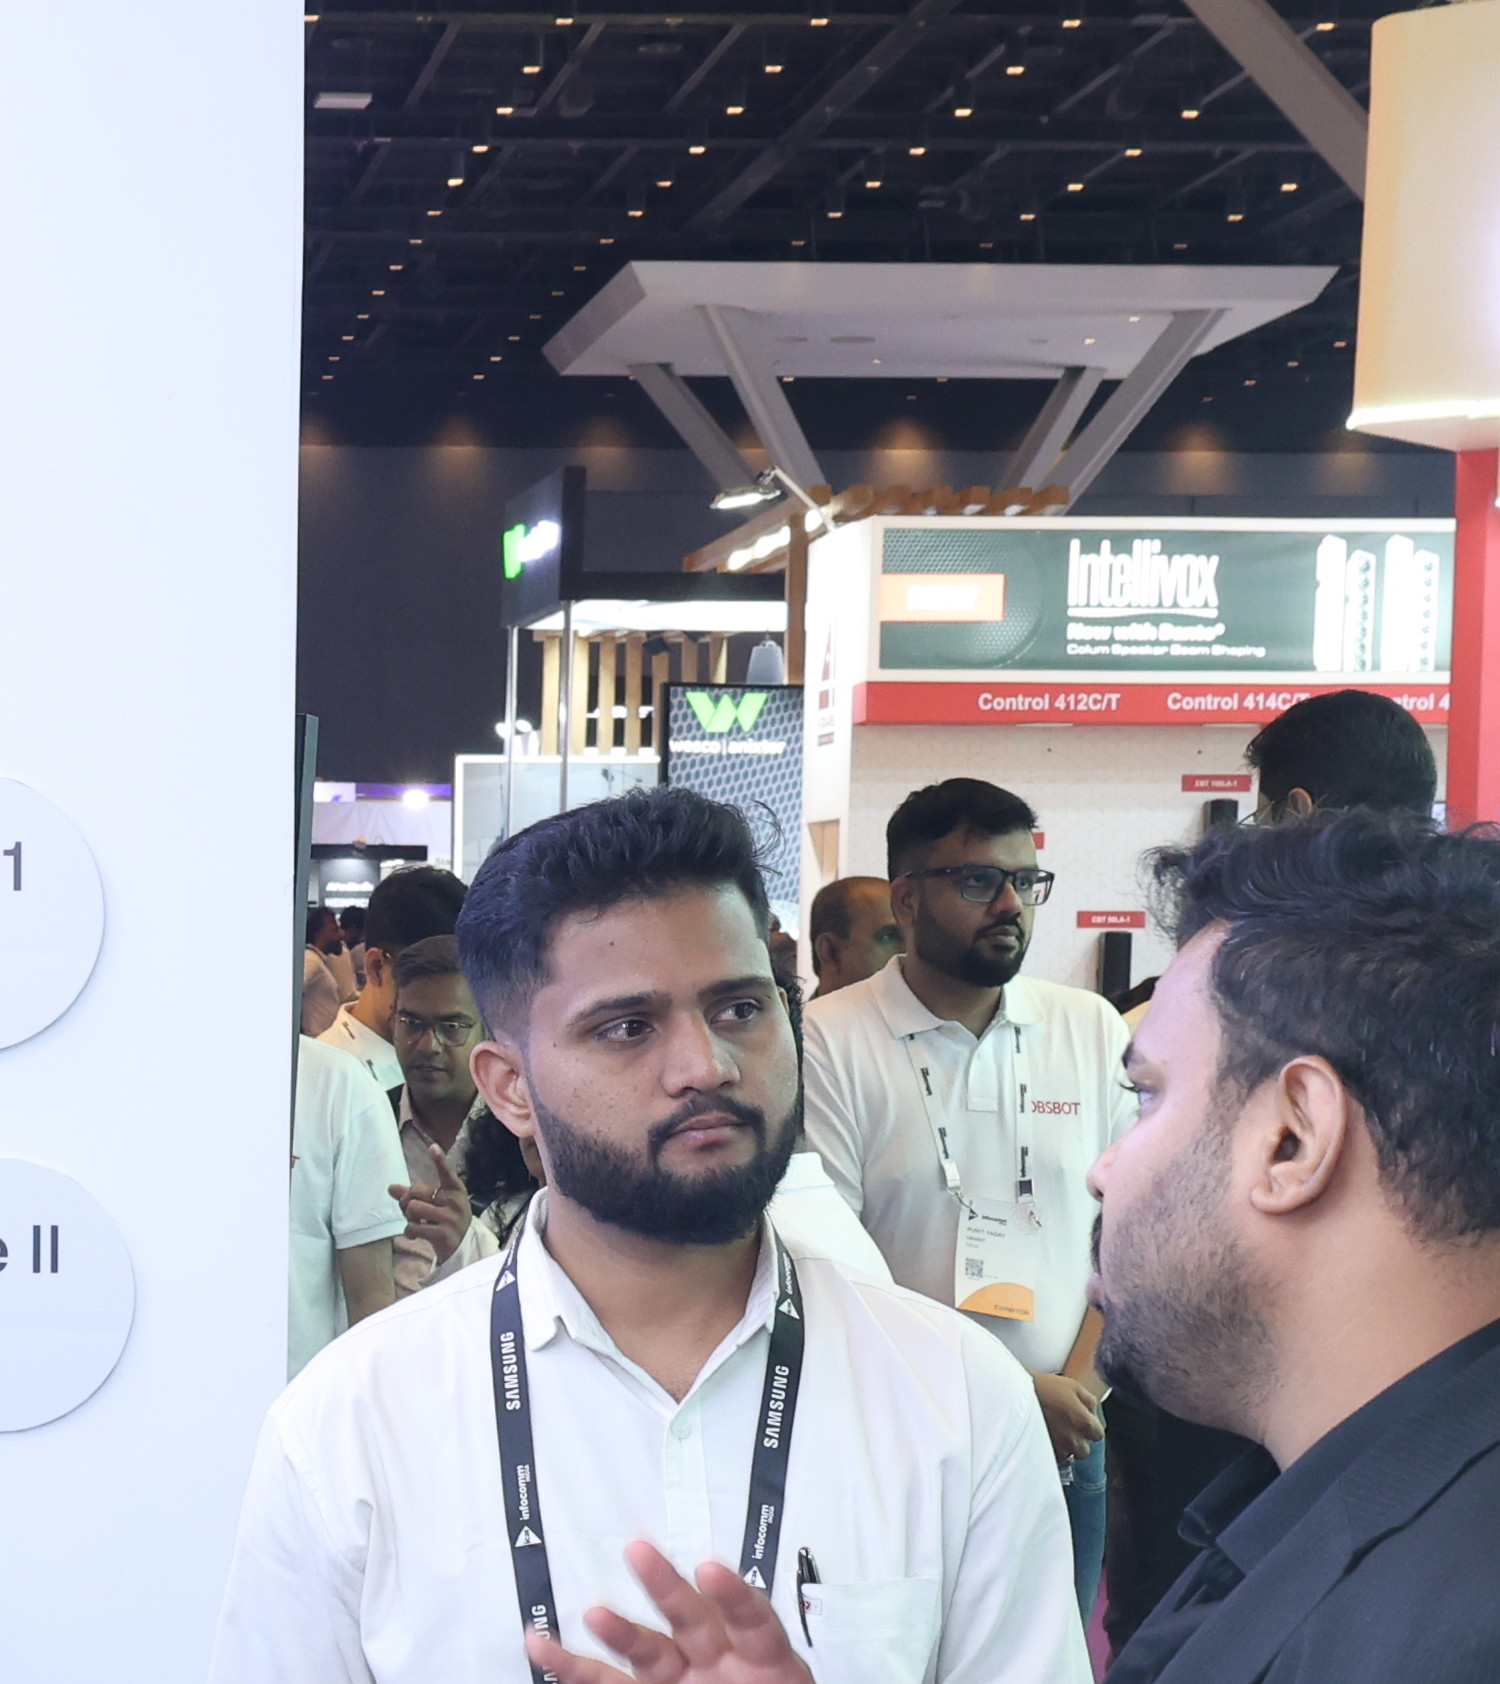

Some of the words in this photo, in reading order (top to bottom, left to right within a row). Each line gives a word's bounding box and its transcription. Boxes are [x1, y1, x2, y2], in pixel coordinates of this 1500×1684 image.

[1067, 538, 1219, 608] Intellivox
[978, 692, 1051, 711] Control
[1054, 692, 1121, 711] 412C/T
[1167, 692, 1239, 711] Control
[506, 1330, 521, 1411] SAMSUNG
[763, 1365, 790, 1449] SAMSUNG
[519, 1465, 529, 1522] infocomm
[751, 1504, 770, 1560] infocomm
